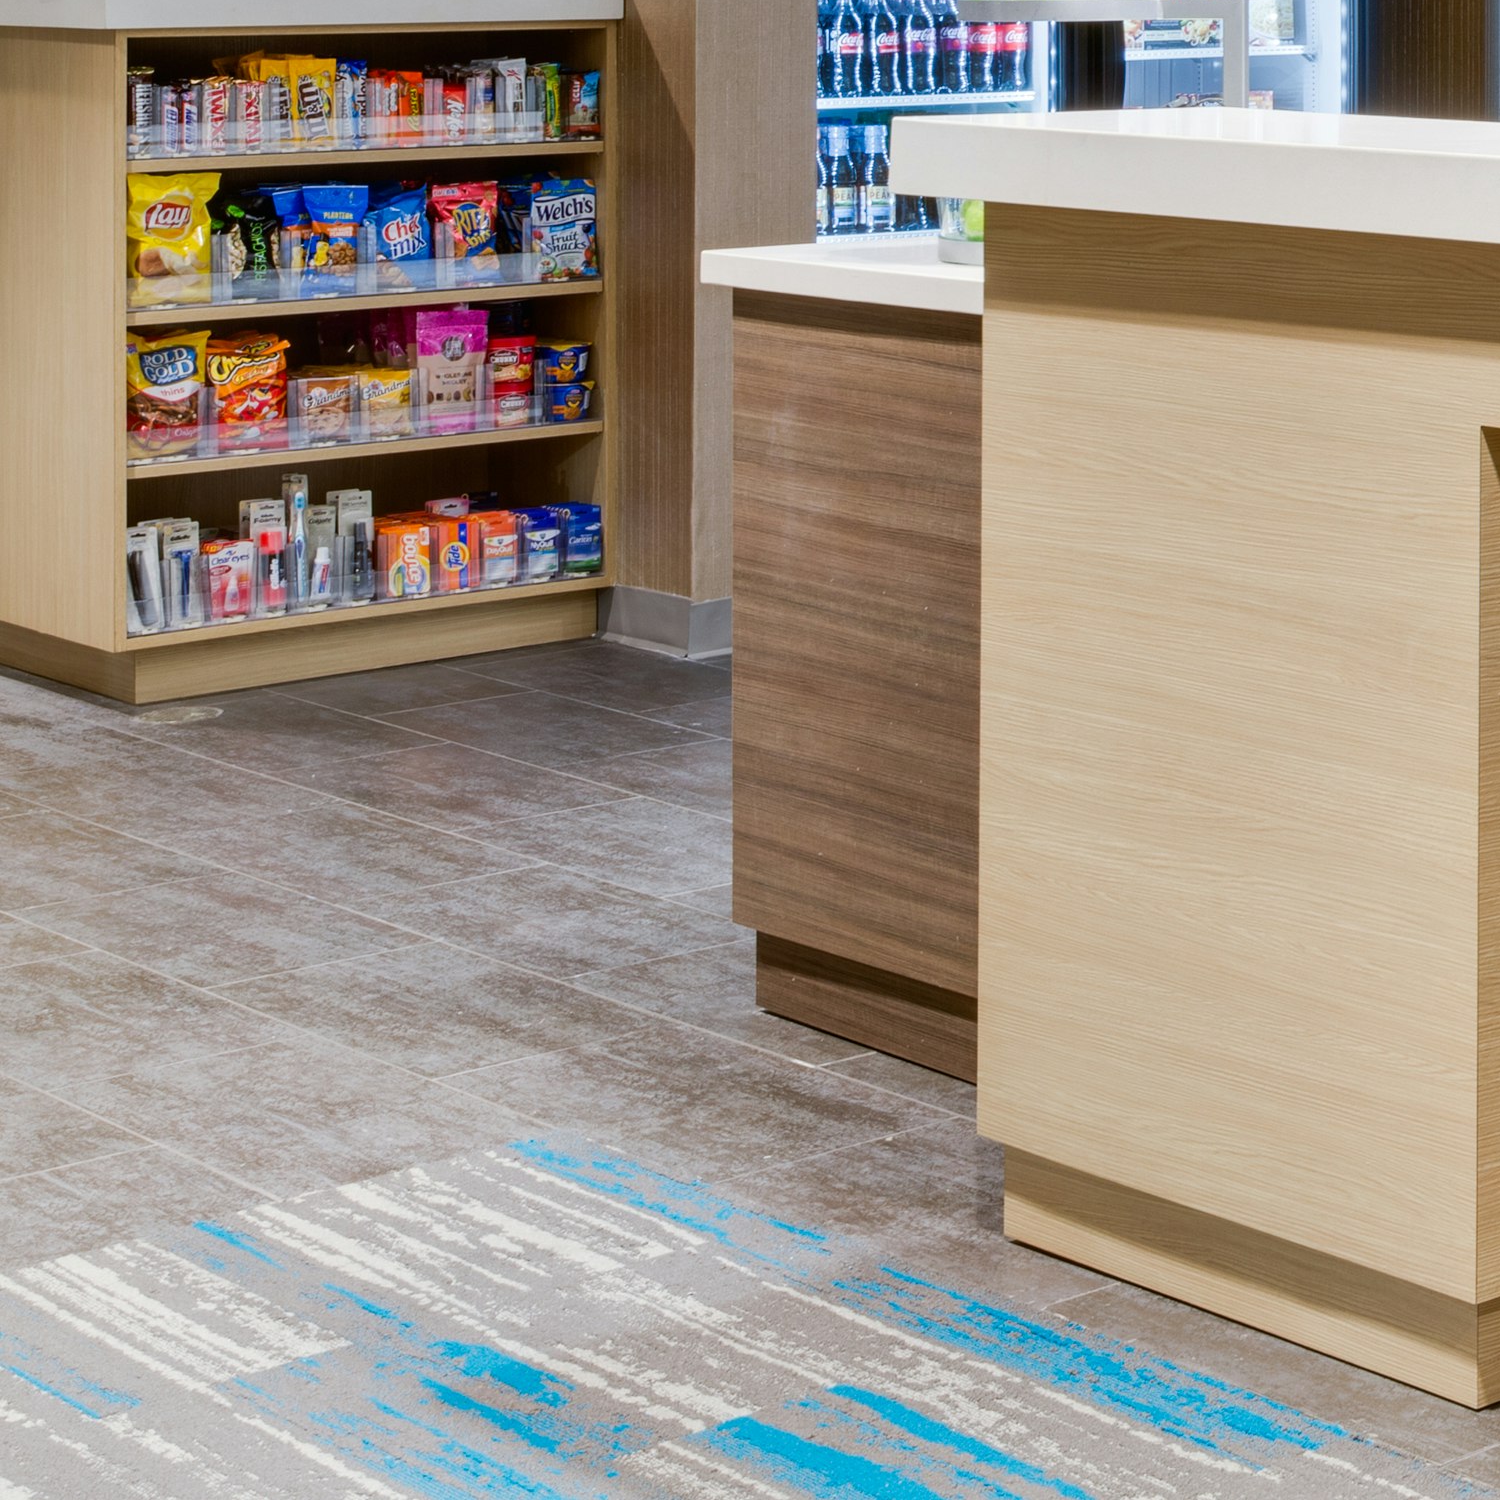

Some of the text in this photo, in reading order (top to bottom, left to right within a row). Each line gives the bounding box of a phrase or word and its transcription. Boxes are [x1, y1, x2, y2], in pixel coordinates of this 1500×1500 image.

[535, 196, 594, 222] Welch's
[550, 230, 579, 246] Fruit
[545, 239, 587, 254] Snacks
[211, 553, 250, 566] Clear eyes
[448, 544, 464, 569] Tide
